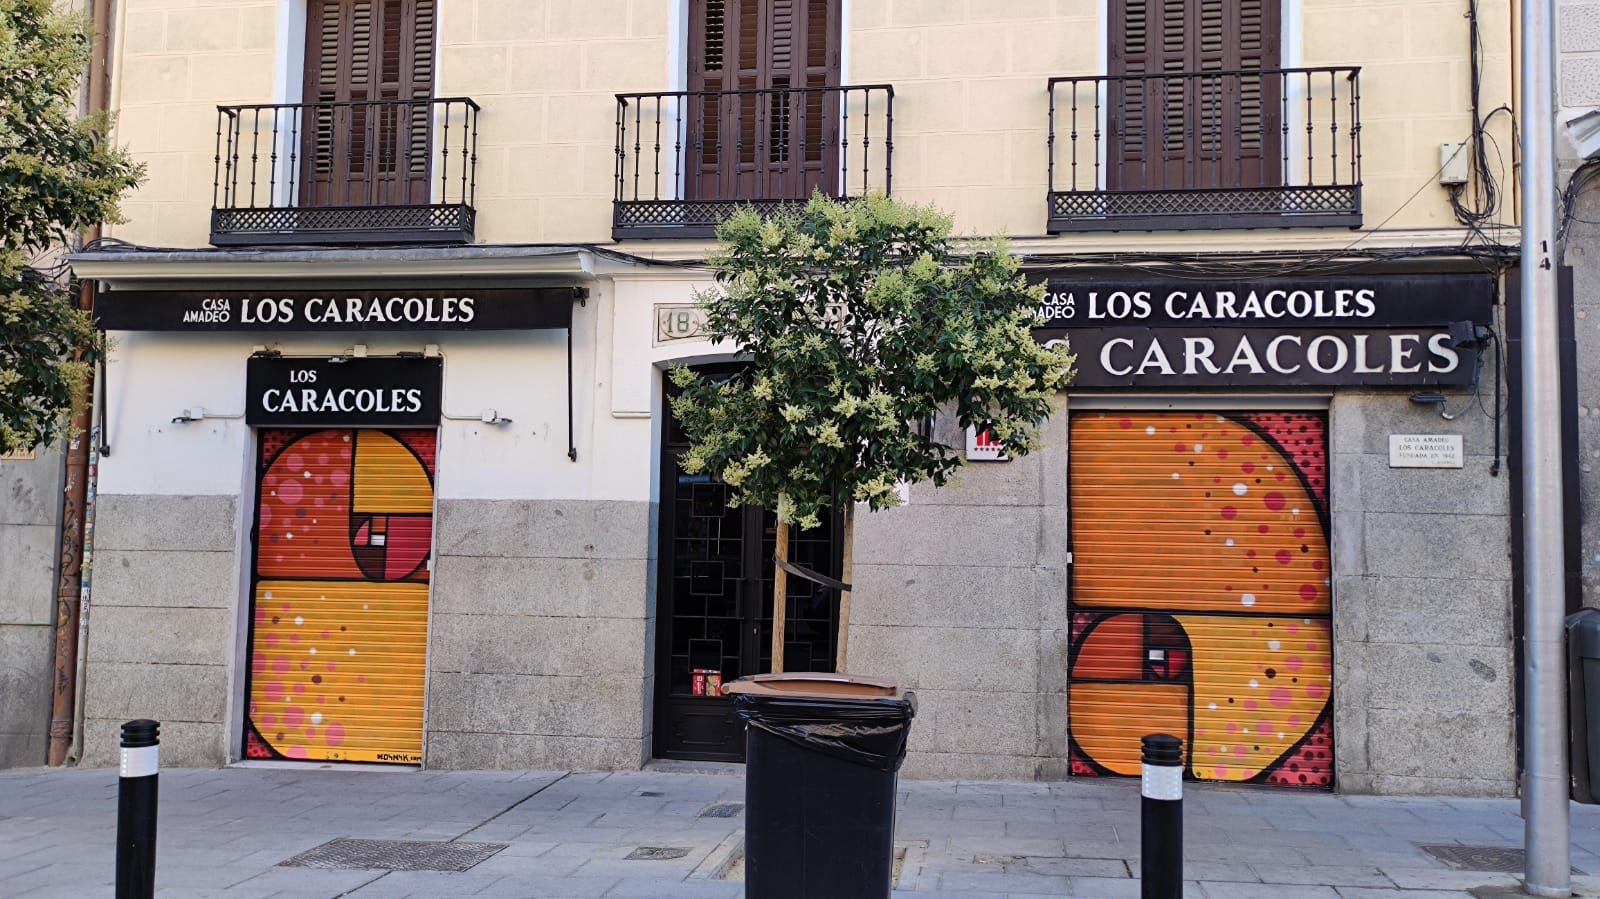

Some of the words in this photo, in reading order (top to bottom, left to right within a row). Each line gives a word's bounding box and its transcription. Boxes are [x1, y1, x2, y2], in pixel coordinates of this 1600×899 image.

[202, 298, 231, 311] CASA
[240, 298, 294, 324] LOS
[304, 297, 474, 324] CARACOLES
[1042, 293, 1075, 306] CASA
[1088, 291, 1151, 319] LOS
[1165, 289, 1376, 319] CARACOLES
[183, 310, 231, 323] AMADEO
[667, 311, 689, 334] 18
[1100, 333, 1459, 376] CARACOLES
[290, 369, 317, 383] LOS
[262, 388, 422, 413] CARACOLES
